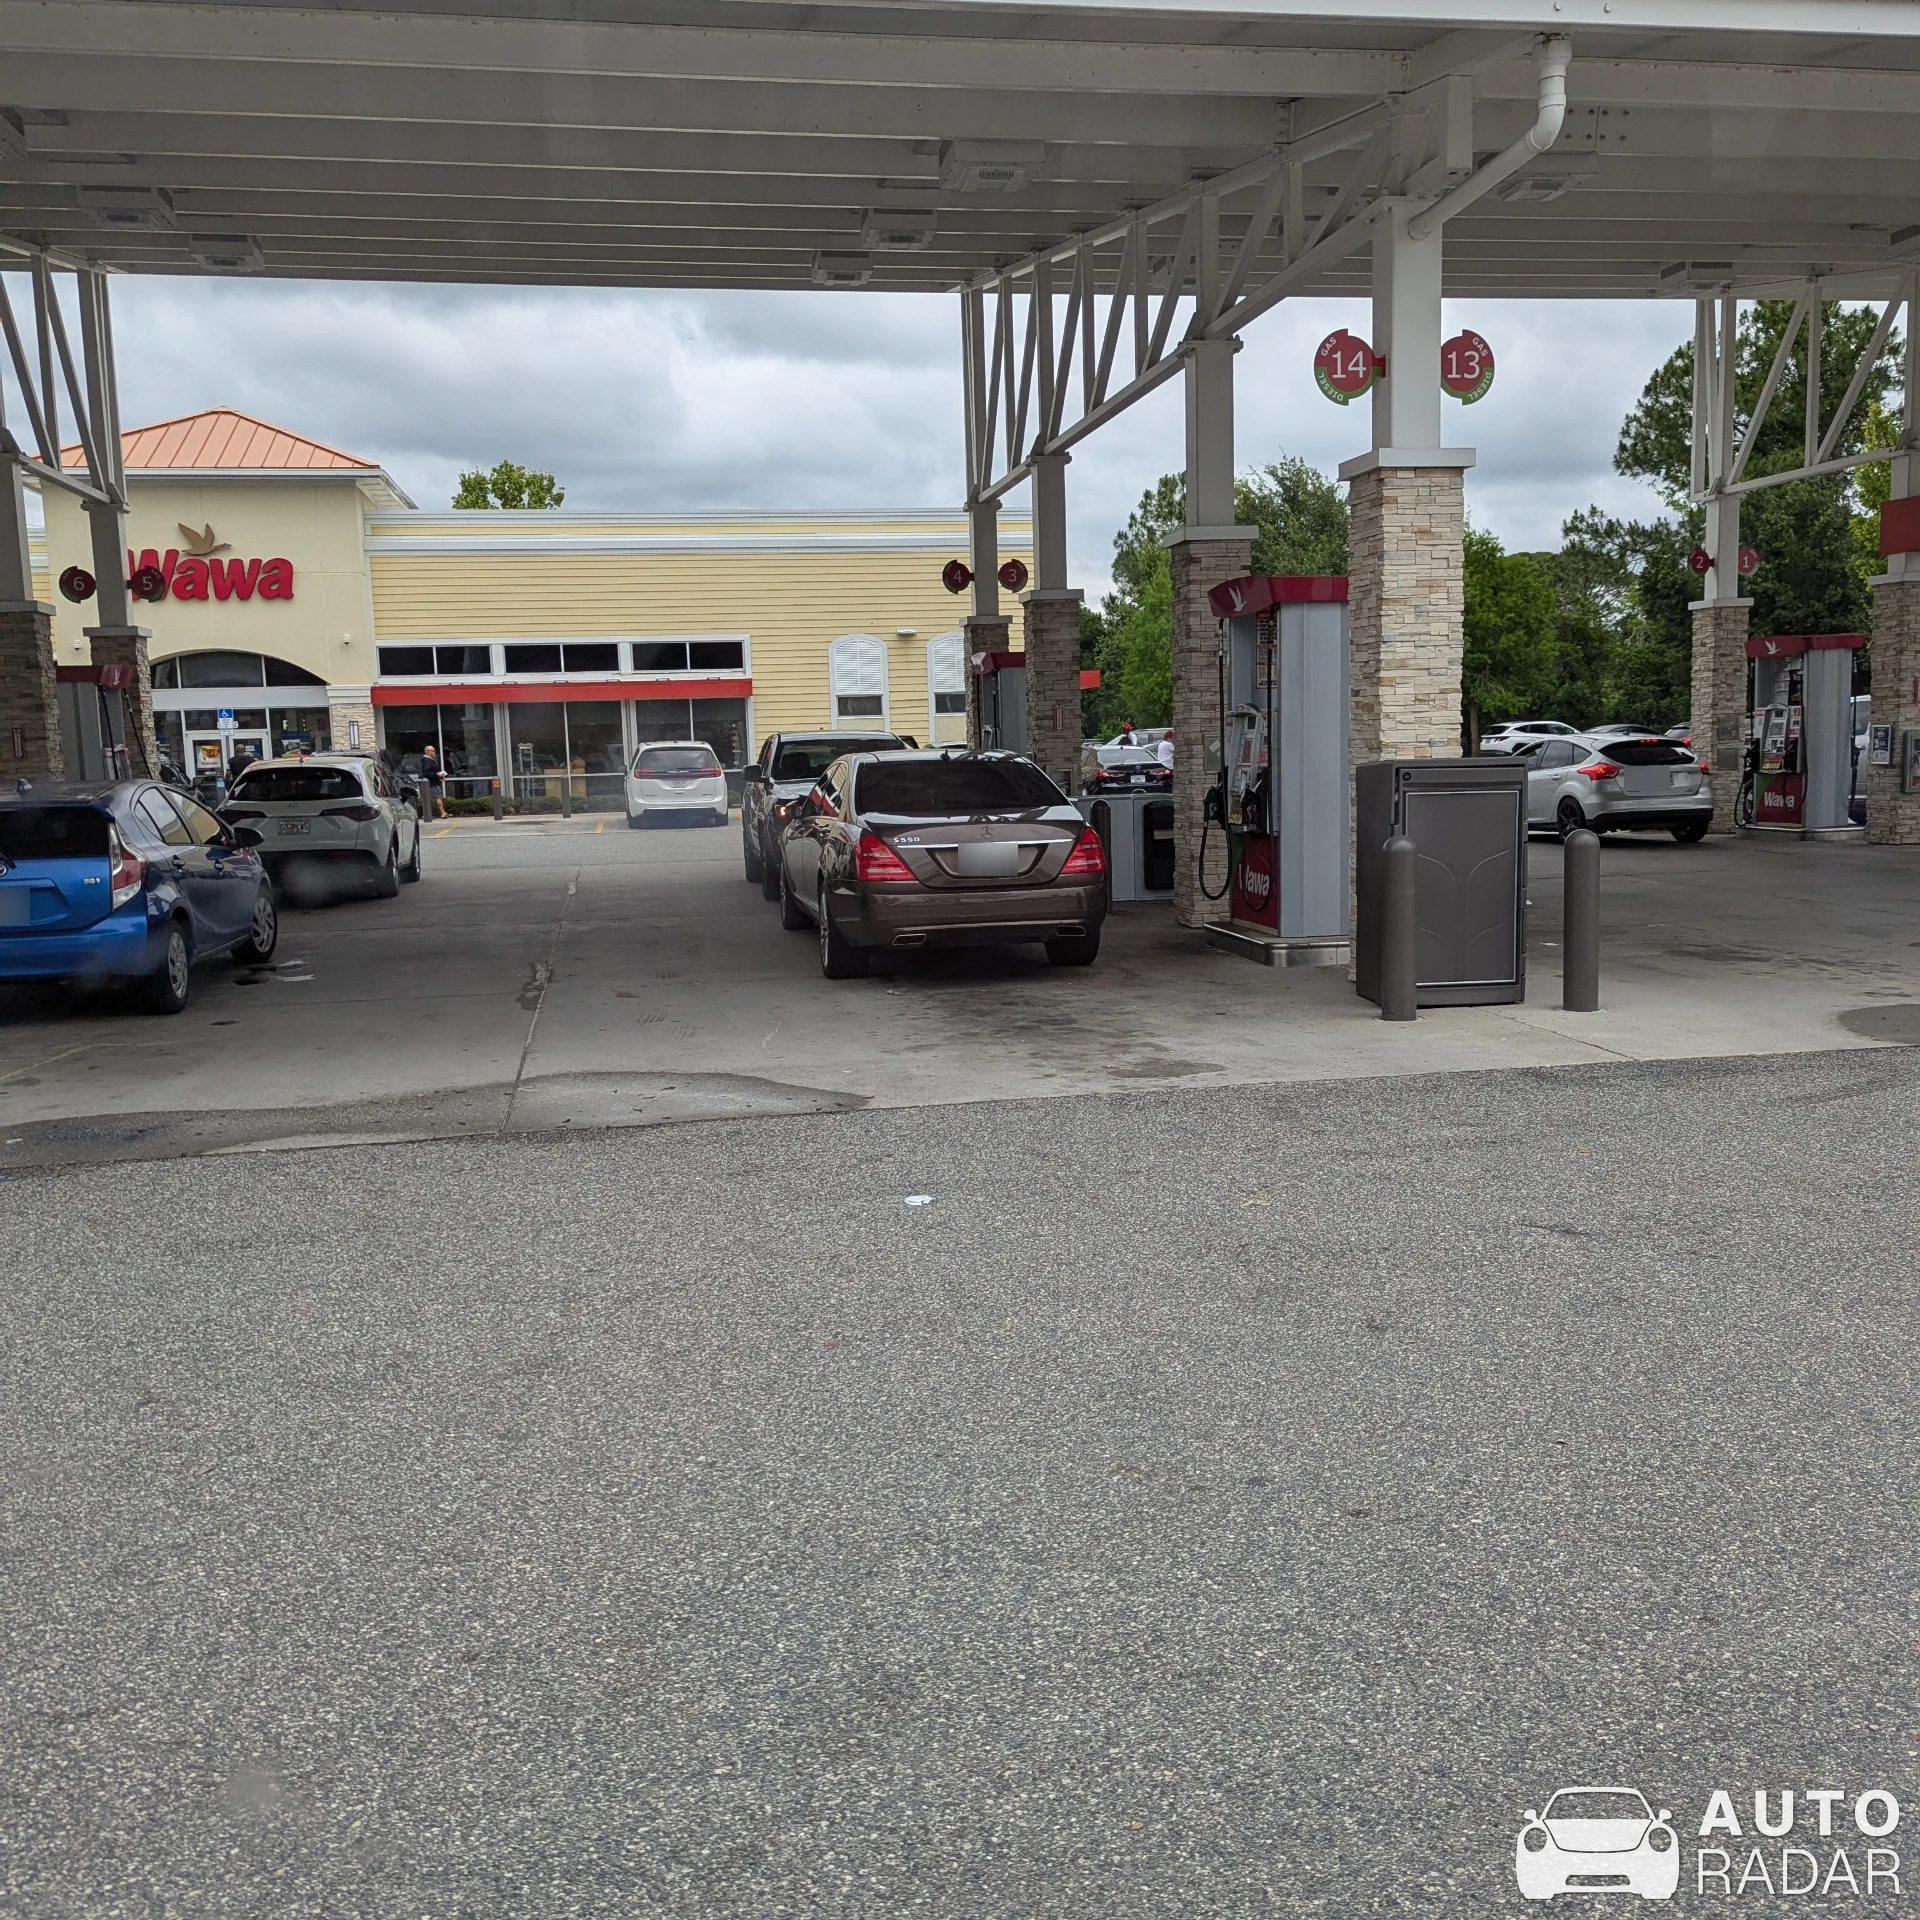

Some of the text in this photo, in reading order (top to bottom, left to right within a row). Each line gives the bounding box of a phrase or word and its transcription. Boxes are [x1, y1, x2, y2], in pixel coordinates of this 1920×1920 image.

[1320, 336, 1337, 357] GAS
[1472, 337, 1488, 357] GAS
[1332, 350, 1367, 379] 14
[1447, 351, 1480, 379] 13
[1318, 371, 1344, 402] DIESEL
[1467, 371, 1493, 401] DIESEL
[1695, 556, 1704, 569] 2
[1742, 555, 1750, 568] 1
[73, 576, 85, 591] 6
[127, 548, 294, 602] Wawa
[142, 576, 153, 591] 5
[953, 569, 963, 583] 4
[1008, 568, 1018, 582] 3
